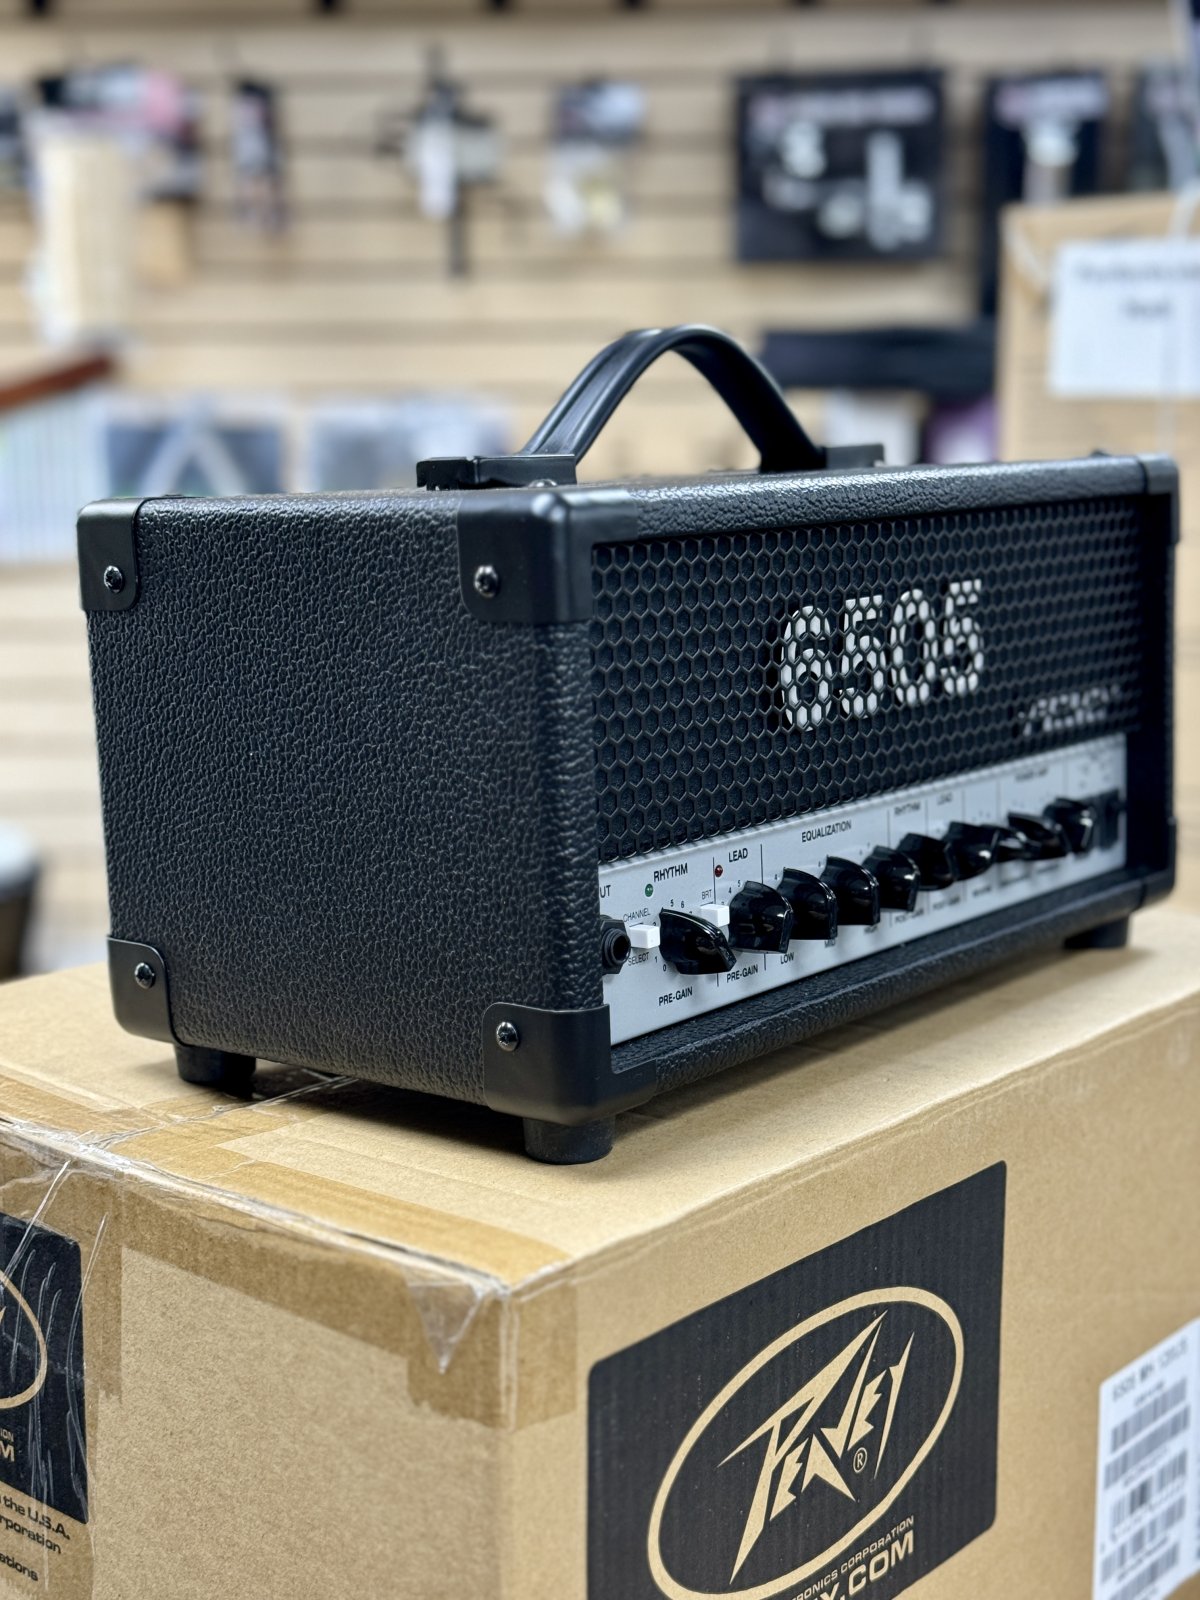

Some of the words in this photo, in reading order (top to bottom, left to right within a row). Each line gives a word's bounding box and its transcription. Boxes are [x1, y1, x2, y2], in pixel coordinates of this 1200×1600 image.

[780, 577, 984, 732] 6505
[801, 820, 852, 842] EQUALIZATION
[728, 848, 748, 862] LEAD
[654, 863, 688, 882] RHYTHM
[622, 907, 651, 923] CHANNEL
[627, 951, 650, 966] SELECT
[662, 963, 667, 972] 0
[780, 952, 795, 965] LOW
[726, 964, 759, 983] PRE-GAIN
[658, 986, 693, 1007] PRE-GAIN
[716, 1309, 915, 1584] PEAVEY
[3, 1495, 26, 1516] the
[28, 1506, 71, 1540] U.S.A.
[840, 1515, 914, 1574] CORPORATION
